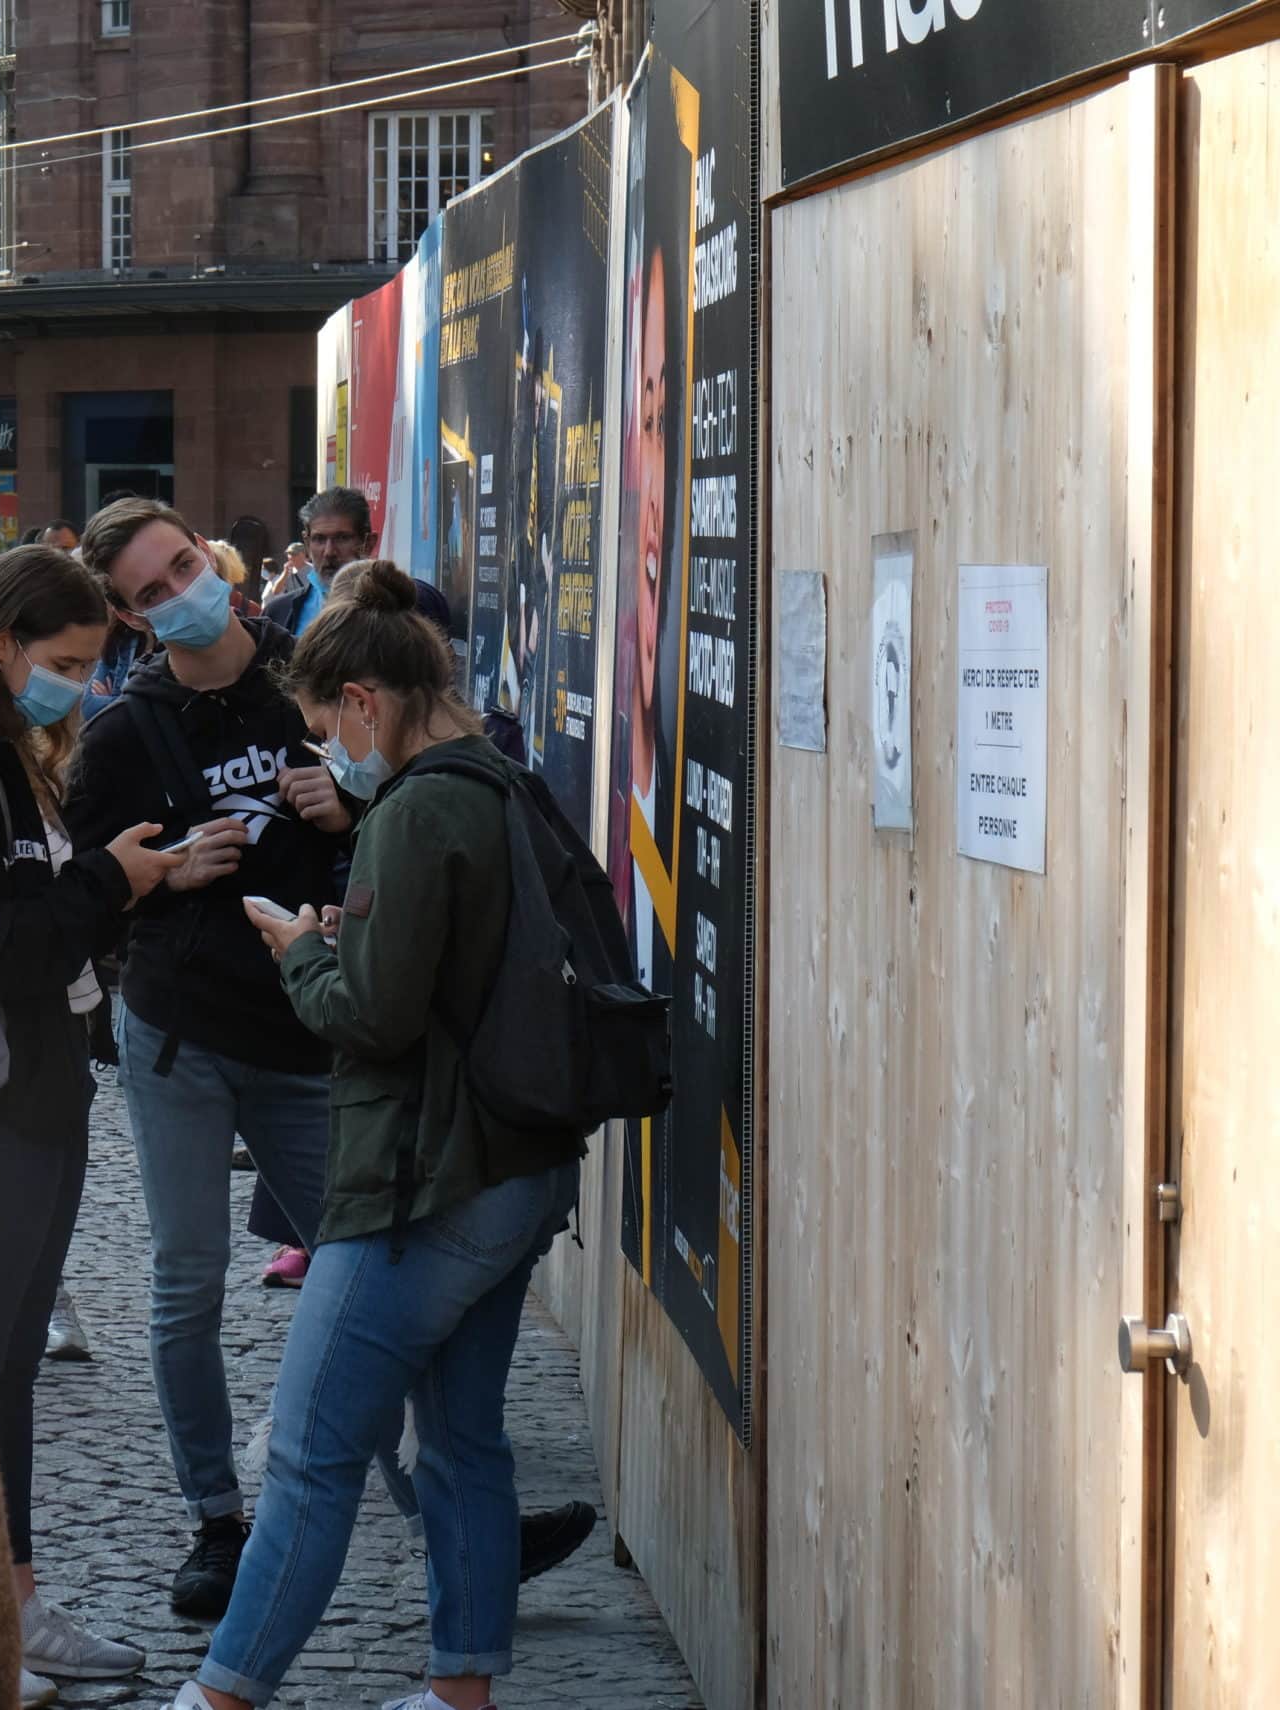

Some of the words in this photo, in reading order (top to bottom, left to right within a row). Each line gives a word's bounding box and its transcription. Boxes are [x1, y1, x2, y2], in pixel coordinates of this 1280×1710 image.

[694, 147, 715, 233] FNAC
[693, 219, 737, 312] STRASBOURG
[692, 370, 737, 459] HIGH-TECH
[692, 475, 737, 538] SMARTPHONES
[689, 622, 735, 708] PHOTO-VIDÉO
[962, 668, 983, 688] MERCI
[985, 668, 996, 688] DE
[996, 668, 1040, 690] RESPECTER
[687, 758, 703, 812] LUNDI
[707, 768, 733, 833] VENDREDI
[970, 772, 995, 795] ENTRE
[996, 775, 1027, 798] CHAQUE
[978, 815, 1017, 840] PERSONNE
[696, 910, 717, 977] SAMEDI
[720, 1148, 740, 1244] fnac
